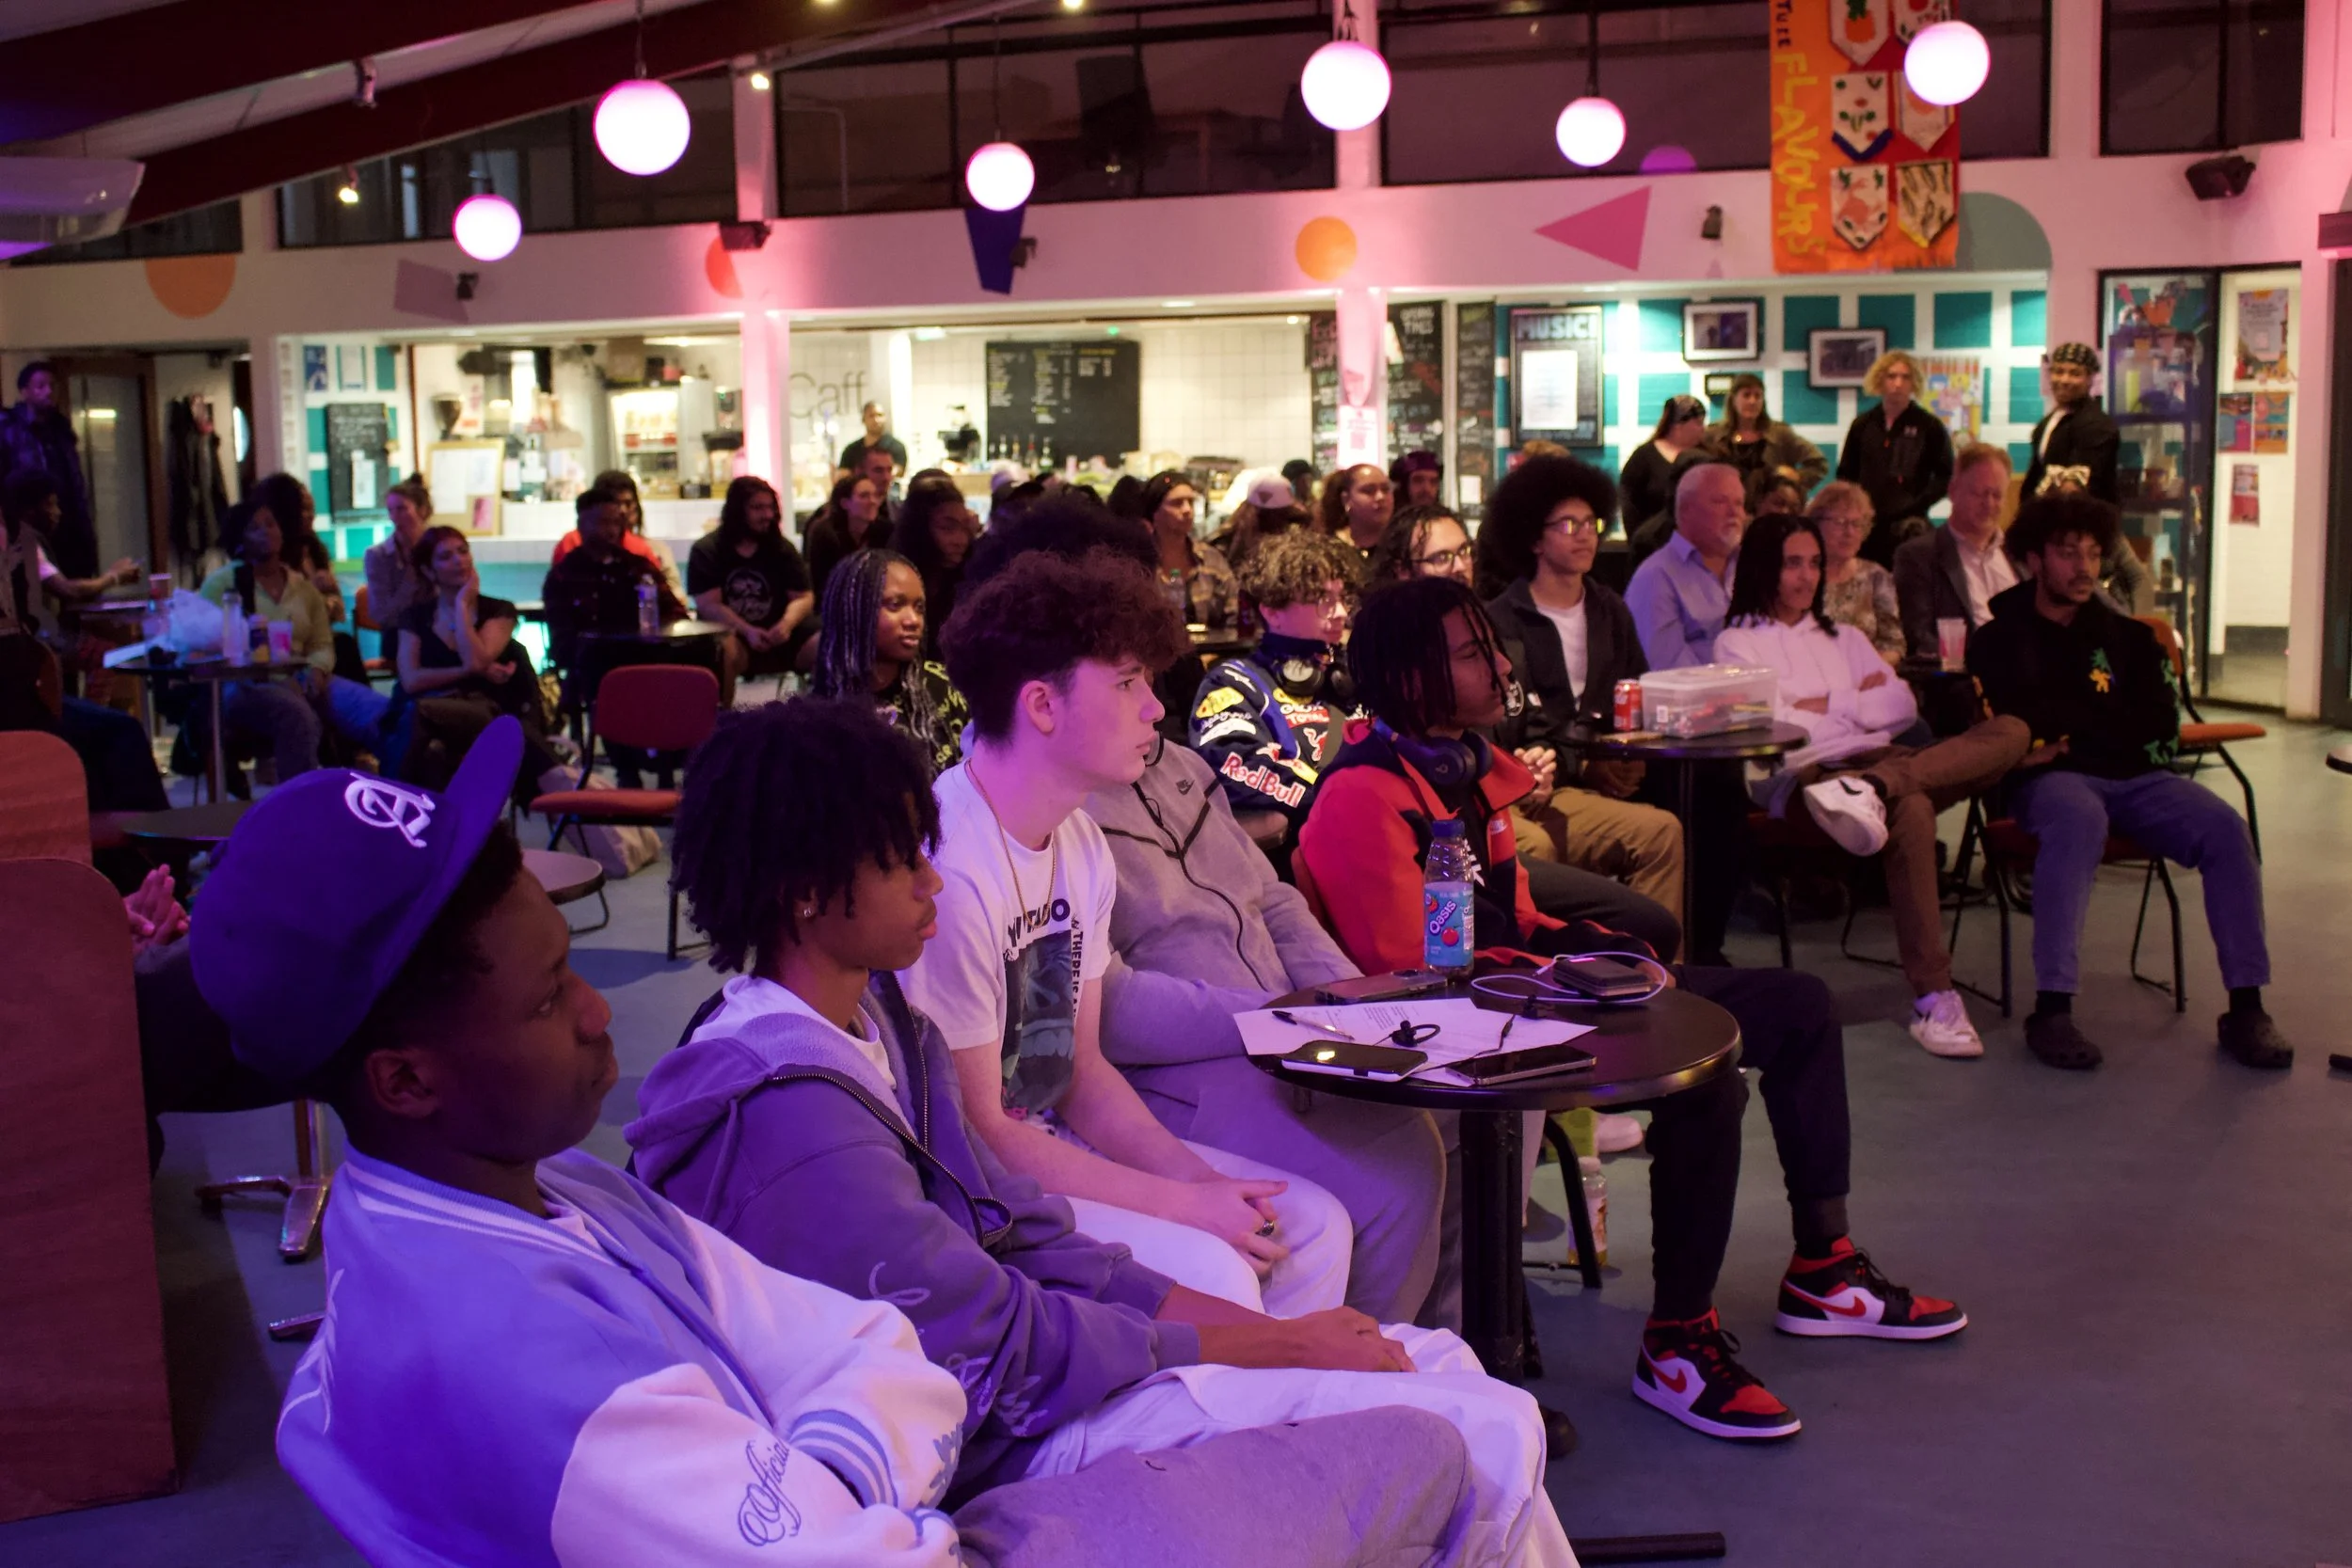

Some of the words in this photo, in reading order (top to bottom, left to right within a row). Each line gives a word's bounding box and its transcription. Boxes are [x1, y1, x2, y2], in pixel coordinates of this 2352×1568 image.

[1772, 52, 1826, 256] FLAVOURS
[1220, 752, 1264, 789] Red
[1260, 767, 1306, 808] Bull
[1429, 900, 1456, 935] Oasis
[1072, 932, 1083, 977] THERE
